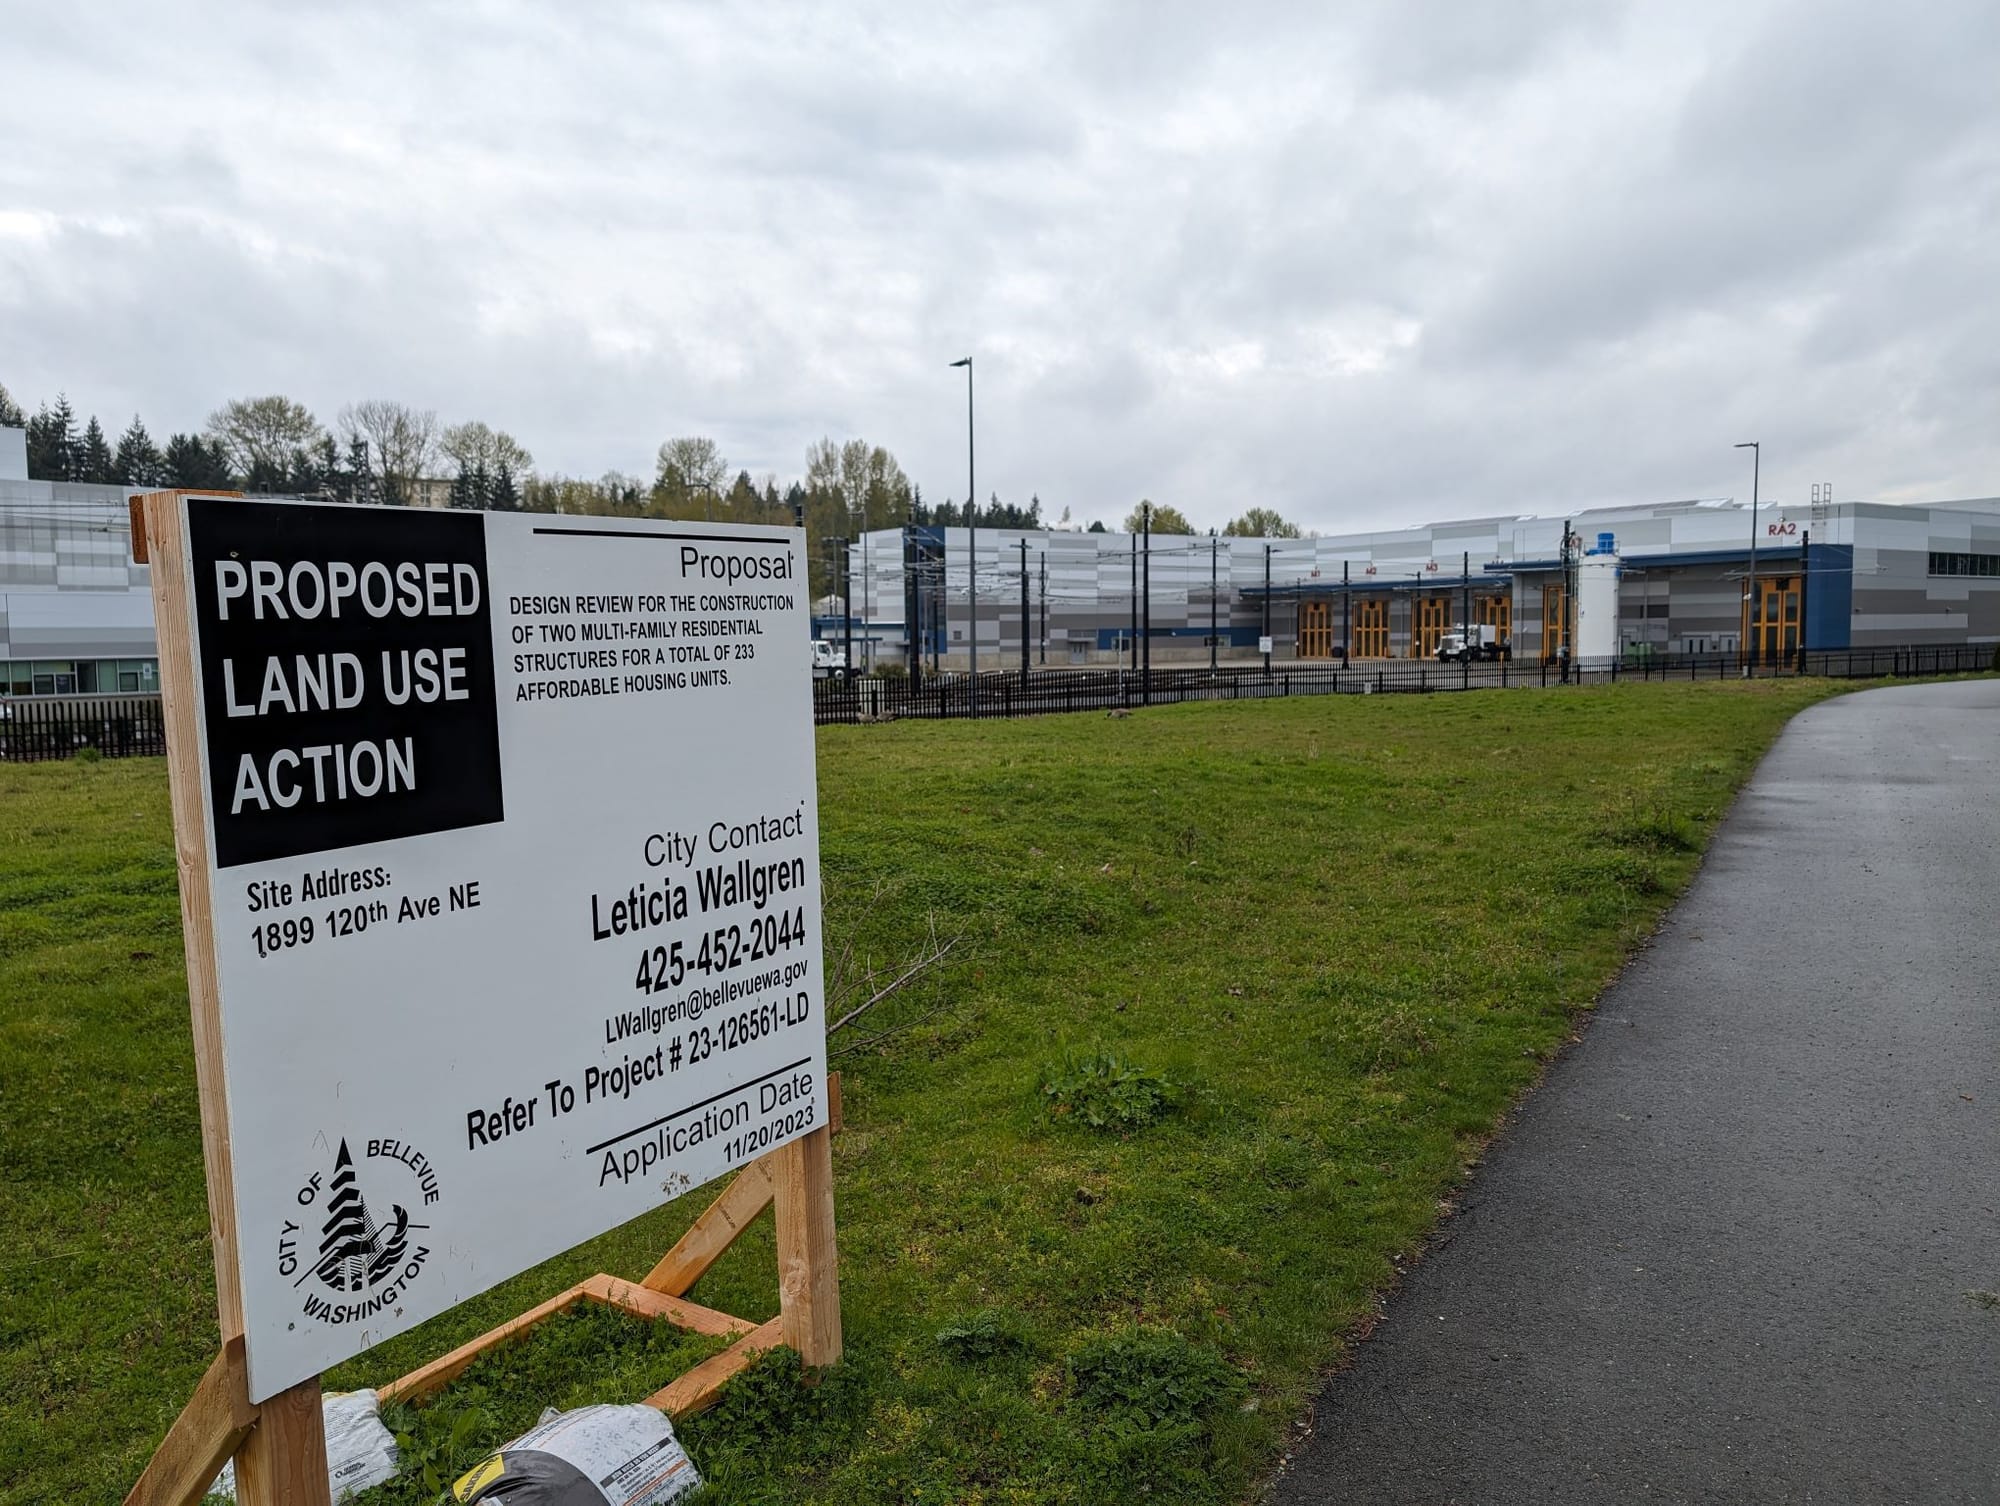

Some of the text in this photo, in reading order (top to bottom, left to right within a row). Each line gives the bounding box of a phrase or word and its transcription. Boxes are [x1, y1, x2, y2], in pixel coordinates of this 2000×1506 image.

[1768, 523, 1796, 536] RA2
[215, 560, 480, 620] PROPOSED
[680, 546, 793, 586] Proposal
[510, 595, 793, 615] DESIGN REVIEW FOR THE CONSTRUCTION
[512, 619, 763, 643] OF TWO MULTI-FAMILY RESIDENTIAL
[223, 648, 469, 717] LAND USE
[514, 643, 755, 672] STRUCTURES FOR A TOTAL OF 233
[516, 669, 731, 701] AFFORDABLE HOUSING UNITS.
[231, 737, 416, 814] ACTION
[644, 808, 803, 868] City Contact
[247, 866, 391, 912] Site Address:
[251, 881, 481, 954] 1899 120th Ave NE
[591, 857, 805, 941] Leticia Wallgren
[635, 905, 805, 995] 425-452-2044
[605, 958, 808, 1044] LWallgren@bellevuewa.gov
[467, 991, 809, 1150] Refer To Project # 23-126561-LD
[599, 1072, 813, 1187] Application Date
[723, 1104, 814, 1163] 11/20/2023
[279, 1139, 439, 1277] CITY OF BELLEVUE
[303, 1246, 430, 1324] WASHINGTON
